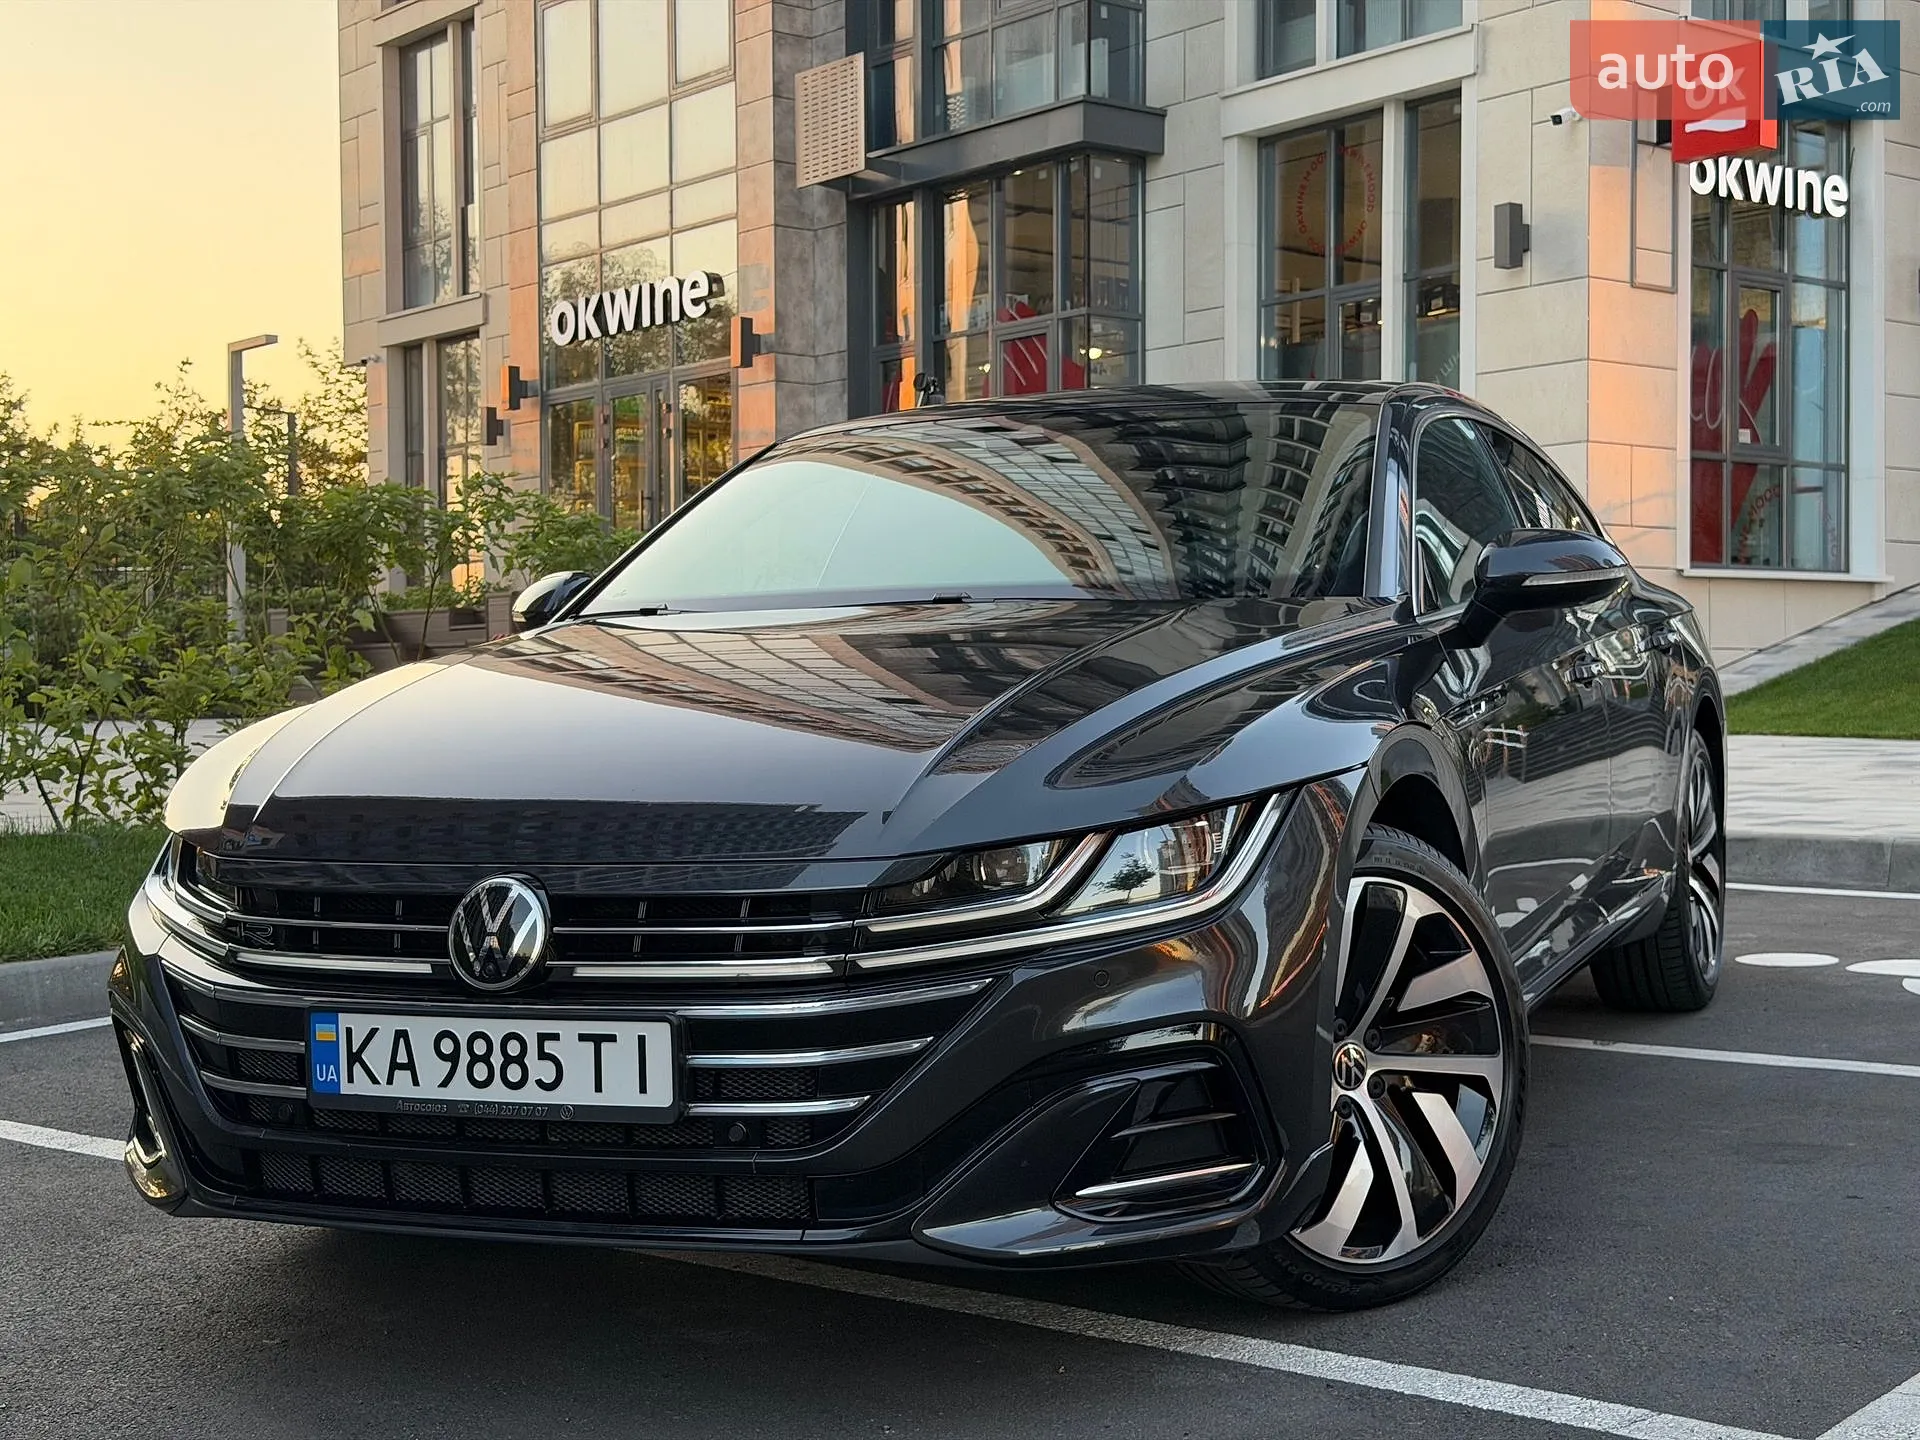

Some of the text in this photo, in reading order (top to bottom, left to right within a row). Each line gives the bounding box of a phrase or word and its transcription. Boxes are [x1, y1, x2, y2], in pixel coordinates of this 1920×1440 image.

[345, 1026, 648, 1095] KA 9885 TI
[316, 1063, 338, 1083] UA
[474, 1102, 499, 1116] (044)
[501, 1104, 519, 1116] 207
[520, 1105, 534, 1117] 07
[535, 1106, 549, 1117] 07
